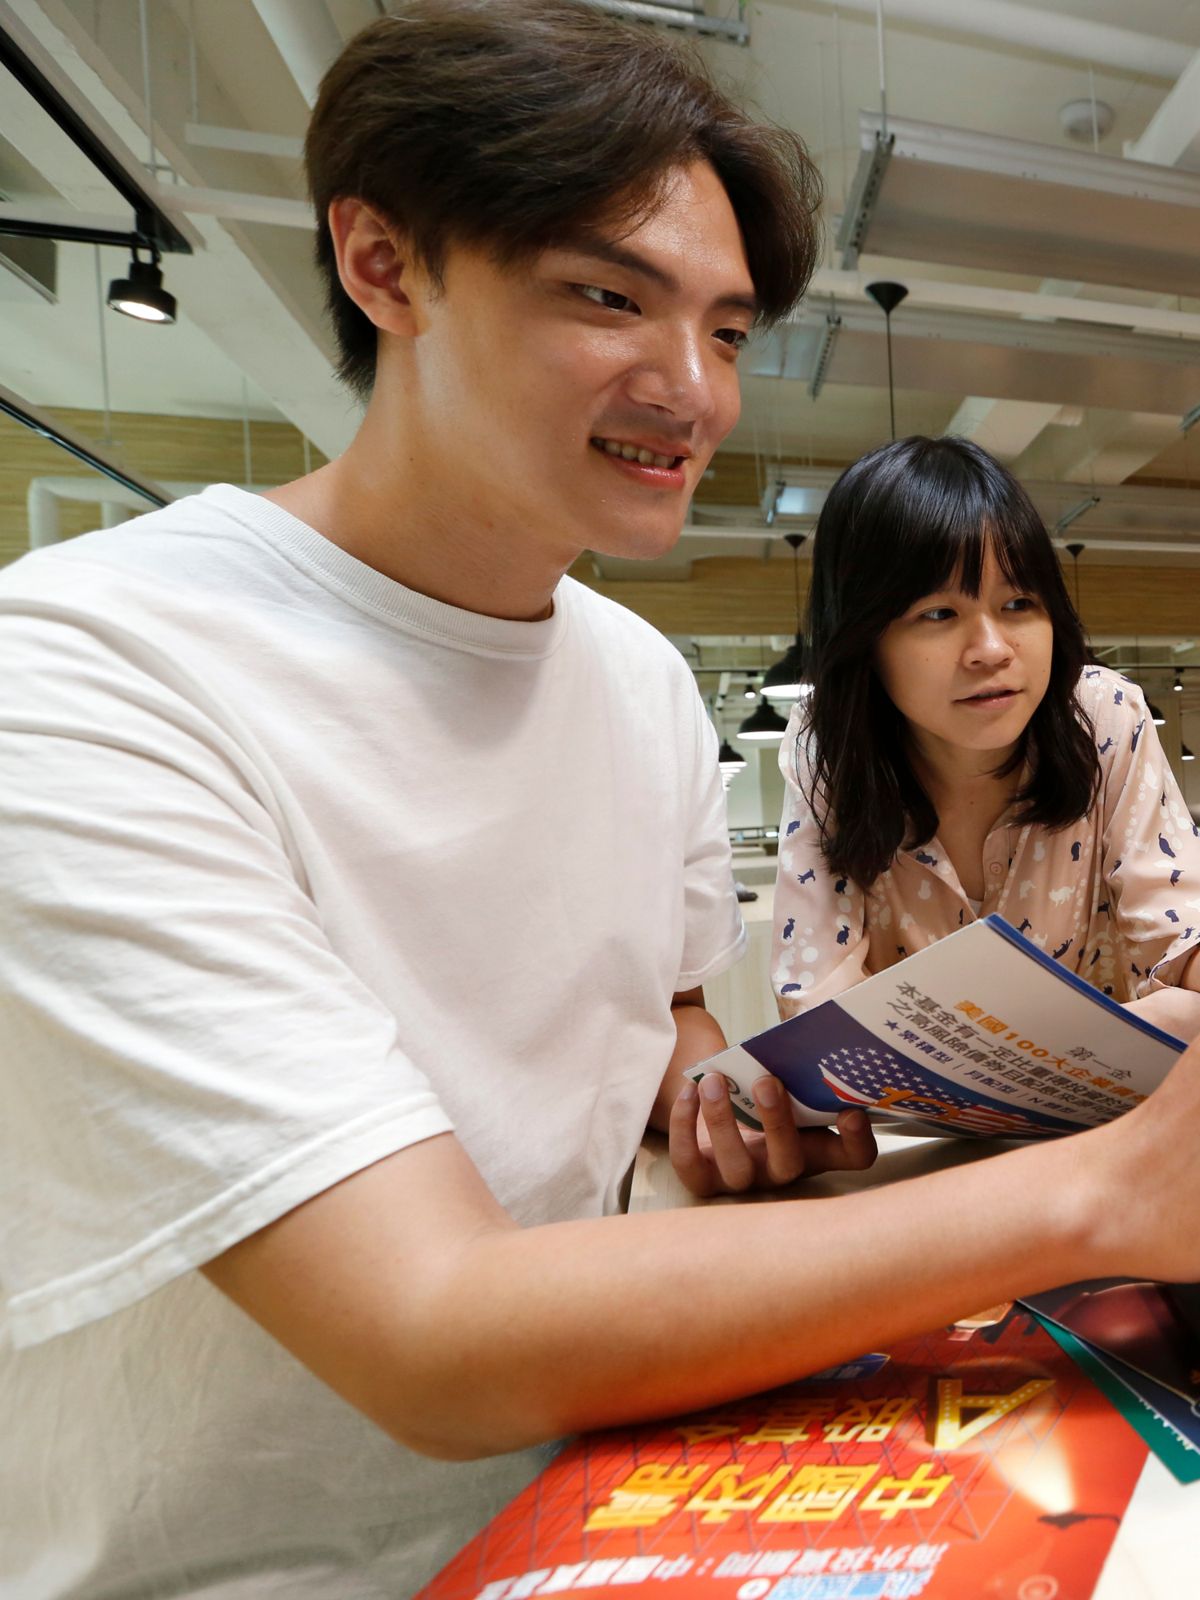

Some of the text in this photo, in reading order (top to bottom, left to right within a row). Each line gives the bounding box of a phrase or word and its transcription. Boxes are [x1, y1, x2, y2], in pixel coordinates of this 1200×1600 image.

[965, 1068, 1021, 1096] 月配型
[1065, 1045, 1133, 1082] 第一金
[583, 1463, 956, 1532] 中國內需
